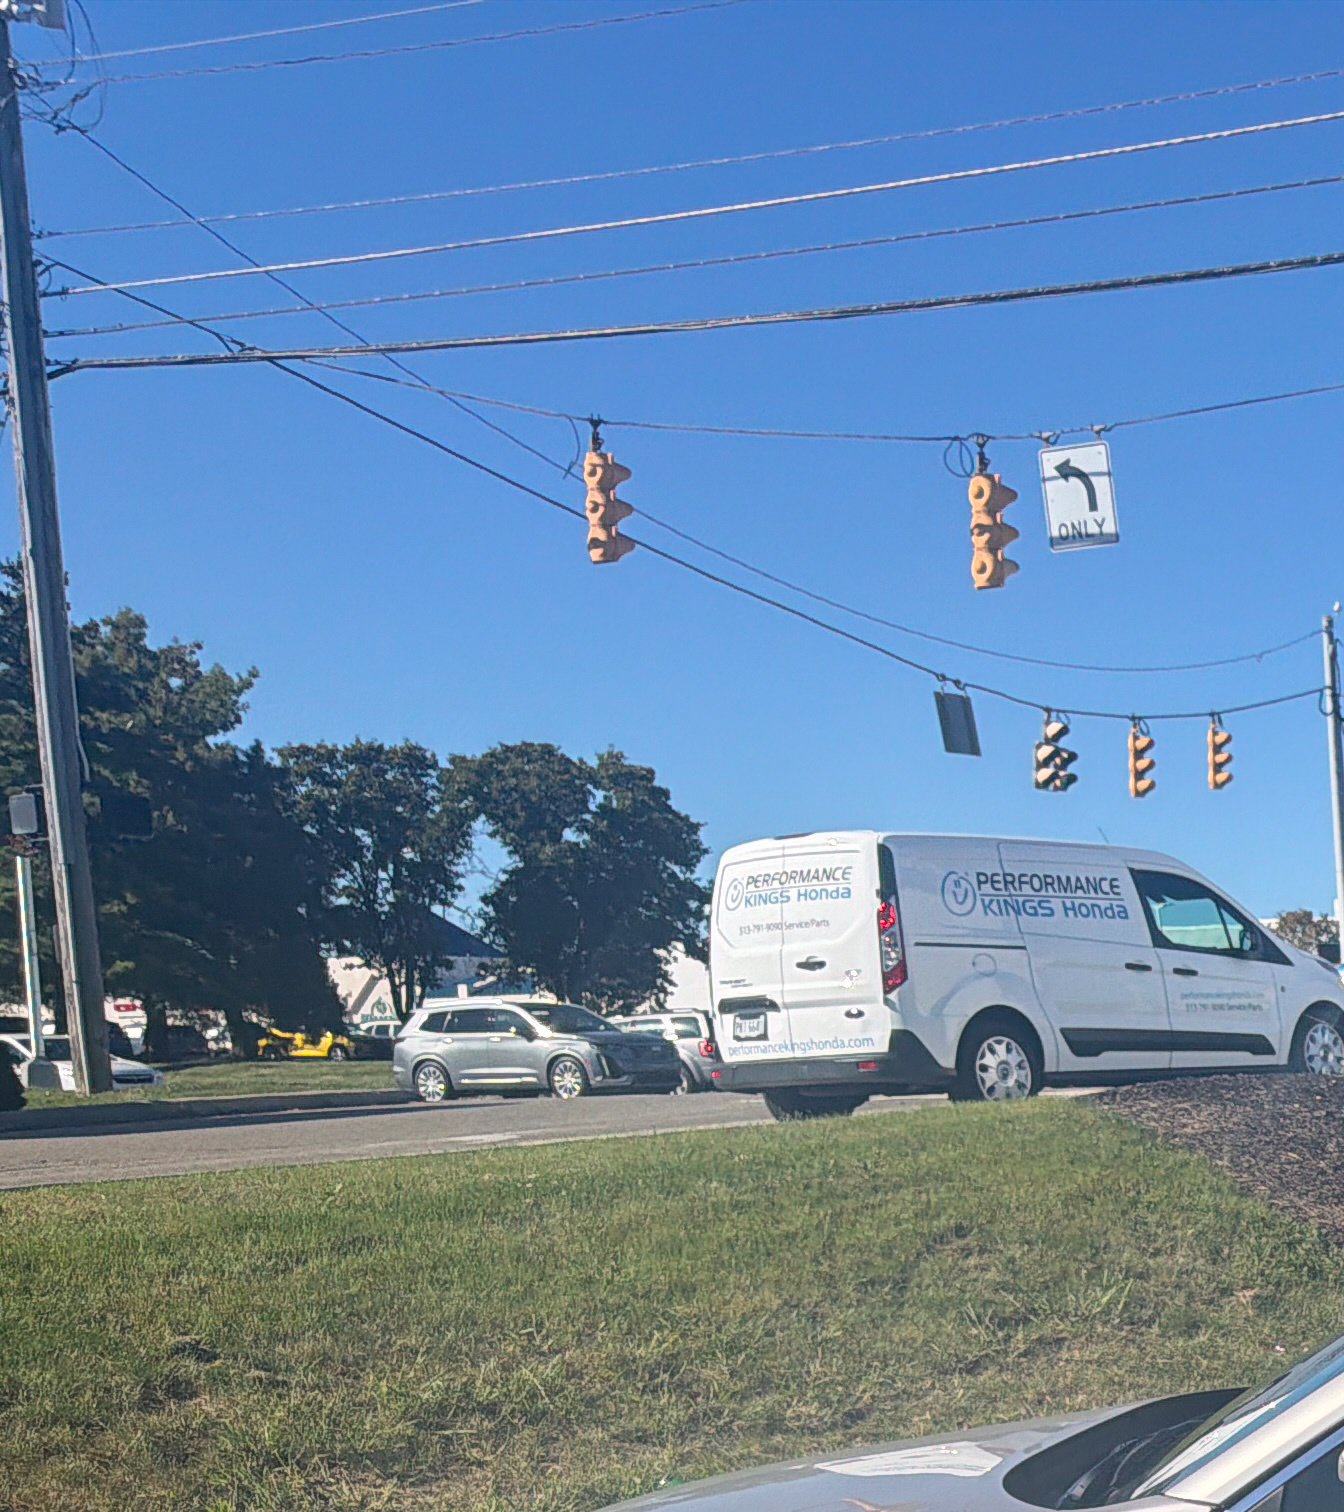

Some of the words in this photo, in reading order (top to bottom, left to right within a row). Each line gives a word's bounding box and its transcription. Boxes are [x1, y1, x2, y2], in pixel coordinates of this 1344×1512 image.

[1058, 517, 1106, 541] ONLY
[746, 866, 853, 889] PERFORMANCE
[976, 871, 1121, 896] PERFORMANCE
[744, 889, 791, 909] KINGS
[797, 886, 852, 902] Honda
[980, 898, 1055, 917] KINGS
[1062, 900, 1130, 920] Honda
[728, 1036, 875, 1058] performancekingshonda.com
